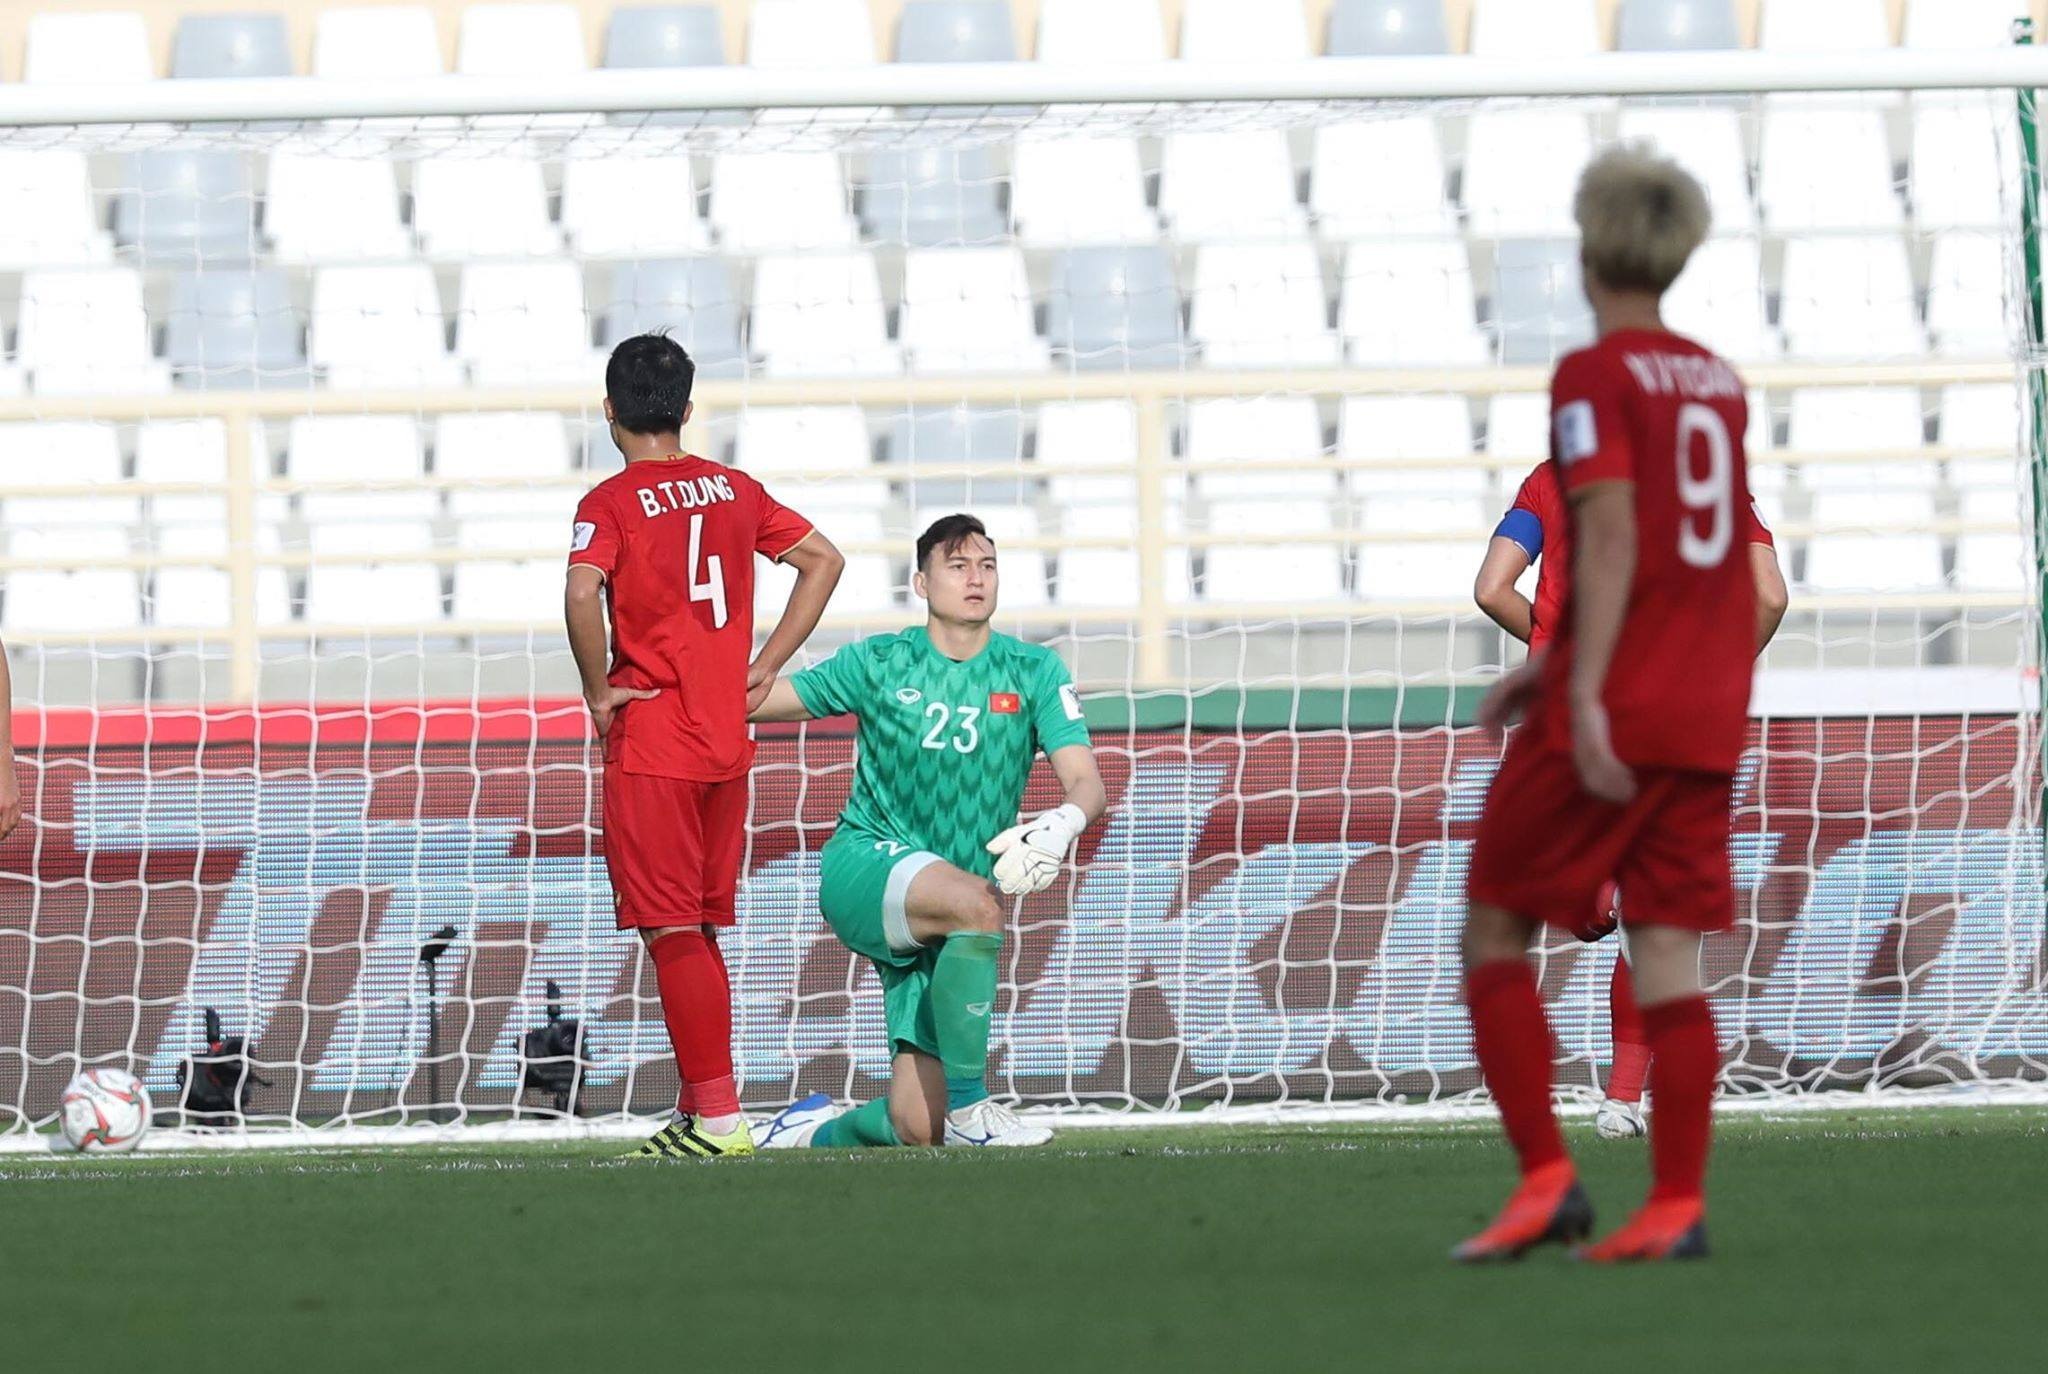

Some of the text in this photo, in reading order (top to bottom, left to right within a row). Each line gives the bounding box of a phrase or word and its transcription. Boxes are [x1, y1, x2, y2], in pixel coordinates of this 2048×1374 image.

[1676, 402, 1733, 568] 9
[688, 514, 728, 629] 4
[921, 701, 980, 753] 23
